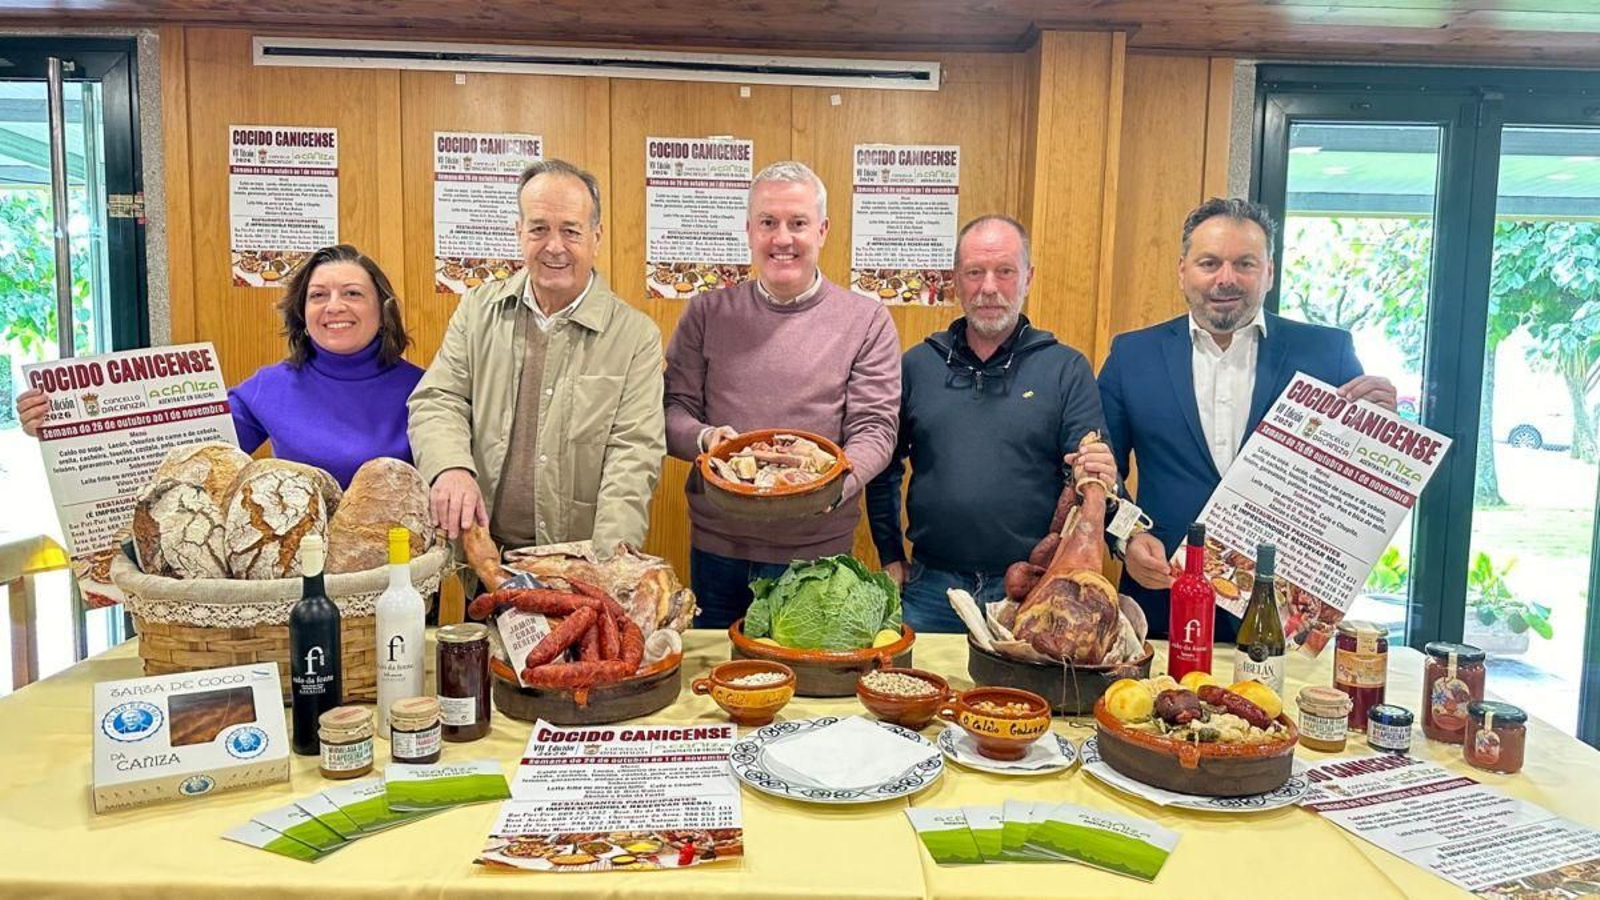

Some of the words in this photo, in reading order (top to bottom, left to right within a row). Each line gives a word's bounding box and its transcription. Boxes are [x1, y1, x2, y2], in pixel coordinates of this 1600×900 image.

[232, 130, 272, 145] COCIDO
[275, 131, 334, 147] CANICENSE
[649, 142, 688, 158] COCIDO
[691, 143, 749, 160] CANICENSE
[857, 149, 895, 165] COCIDO
[898, 150, 956, 165] CANICENSE
[28, 362, 105, 394] COCIDO
[105, 348, 215, 384] CANICENSE
[42, 425, 78, 439] Semana
[78, 423, 91, 433] do
[91, 421, 103, 431] 26
[103, 419, 115, 429] de
[115, 414, 151, 428] outubro
[151, 412, 164, 422] ao
[169, 409, 181, 419] de
[181, 403, 224, 417] novembro
[43, 411, 71, 421] 2026
[1272, 414, 1294, 428] 2026
[1284, 378, 1348, 420] COCIDO
[1338, 402, 1444, 466] CANICENSE
[1312, 450, 1345, 471] outubro
[1342, 465, 1356, 477] ao
[1357, 472, 1371, 484] de
[1368, 477, 1411, 504] novembro
[95, 496, 136, 508] RESTAURA
[1243, 501, 1291, 531] RESTAURANTES
[1290, 527, 1341, 558] PARTICIPANTES
[1289, 535, 1326, 558] RESERVAR
[198, 674, 245, 687] COCO
[537, 727, 615, 742] COCIDO
[620, 727, 732, 742] CANICENSE
